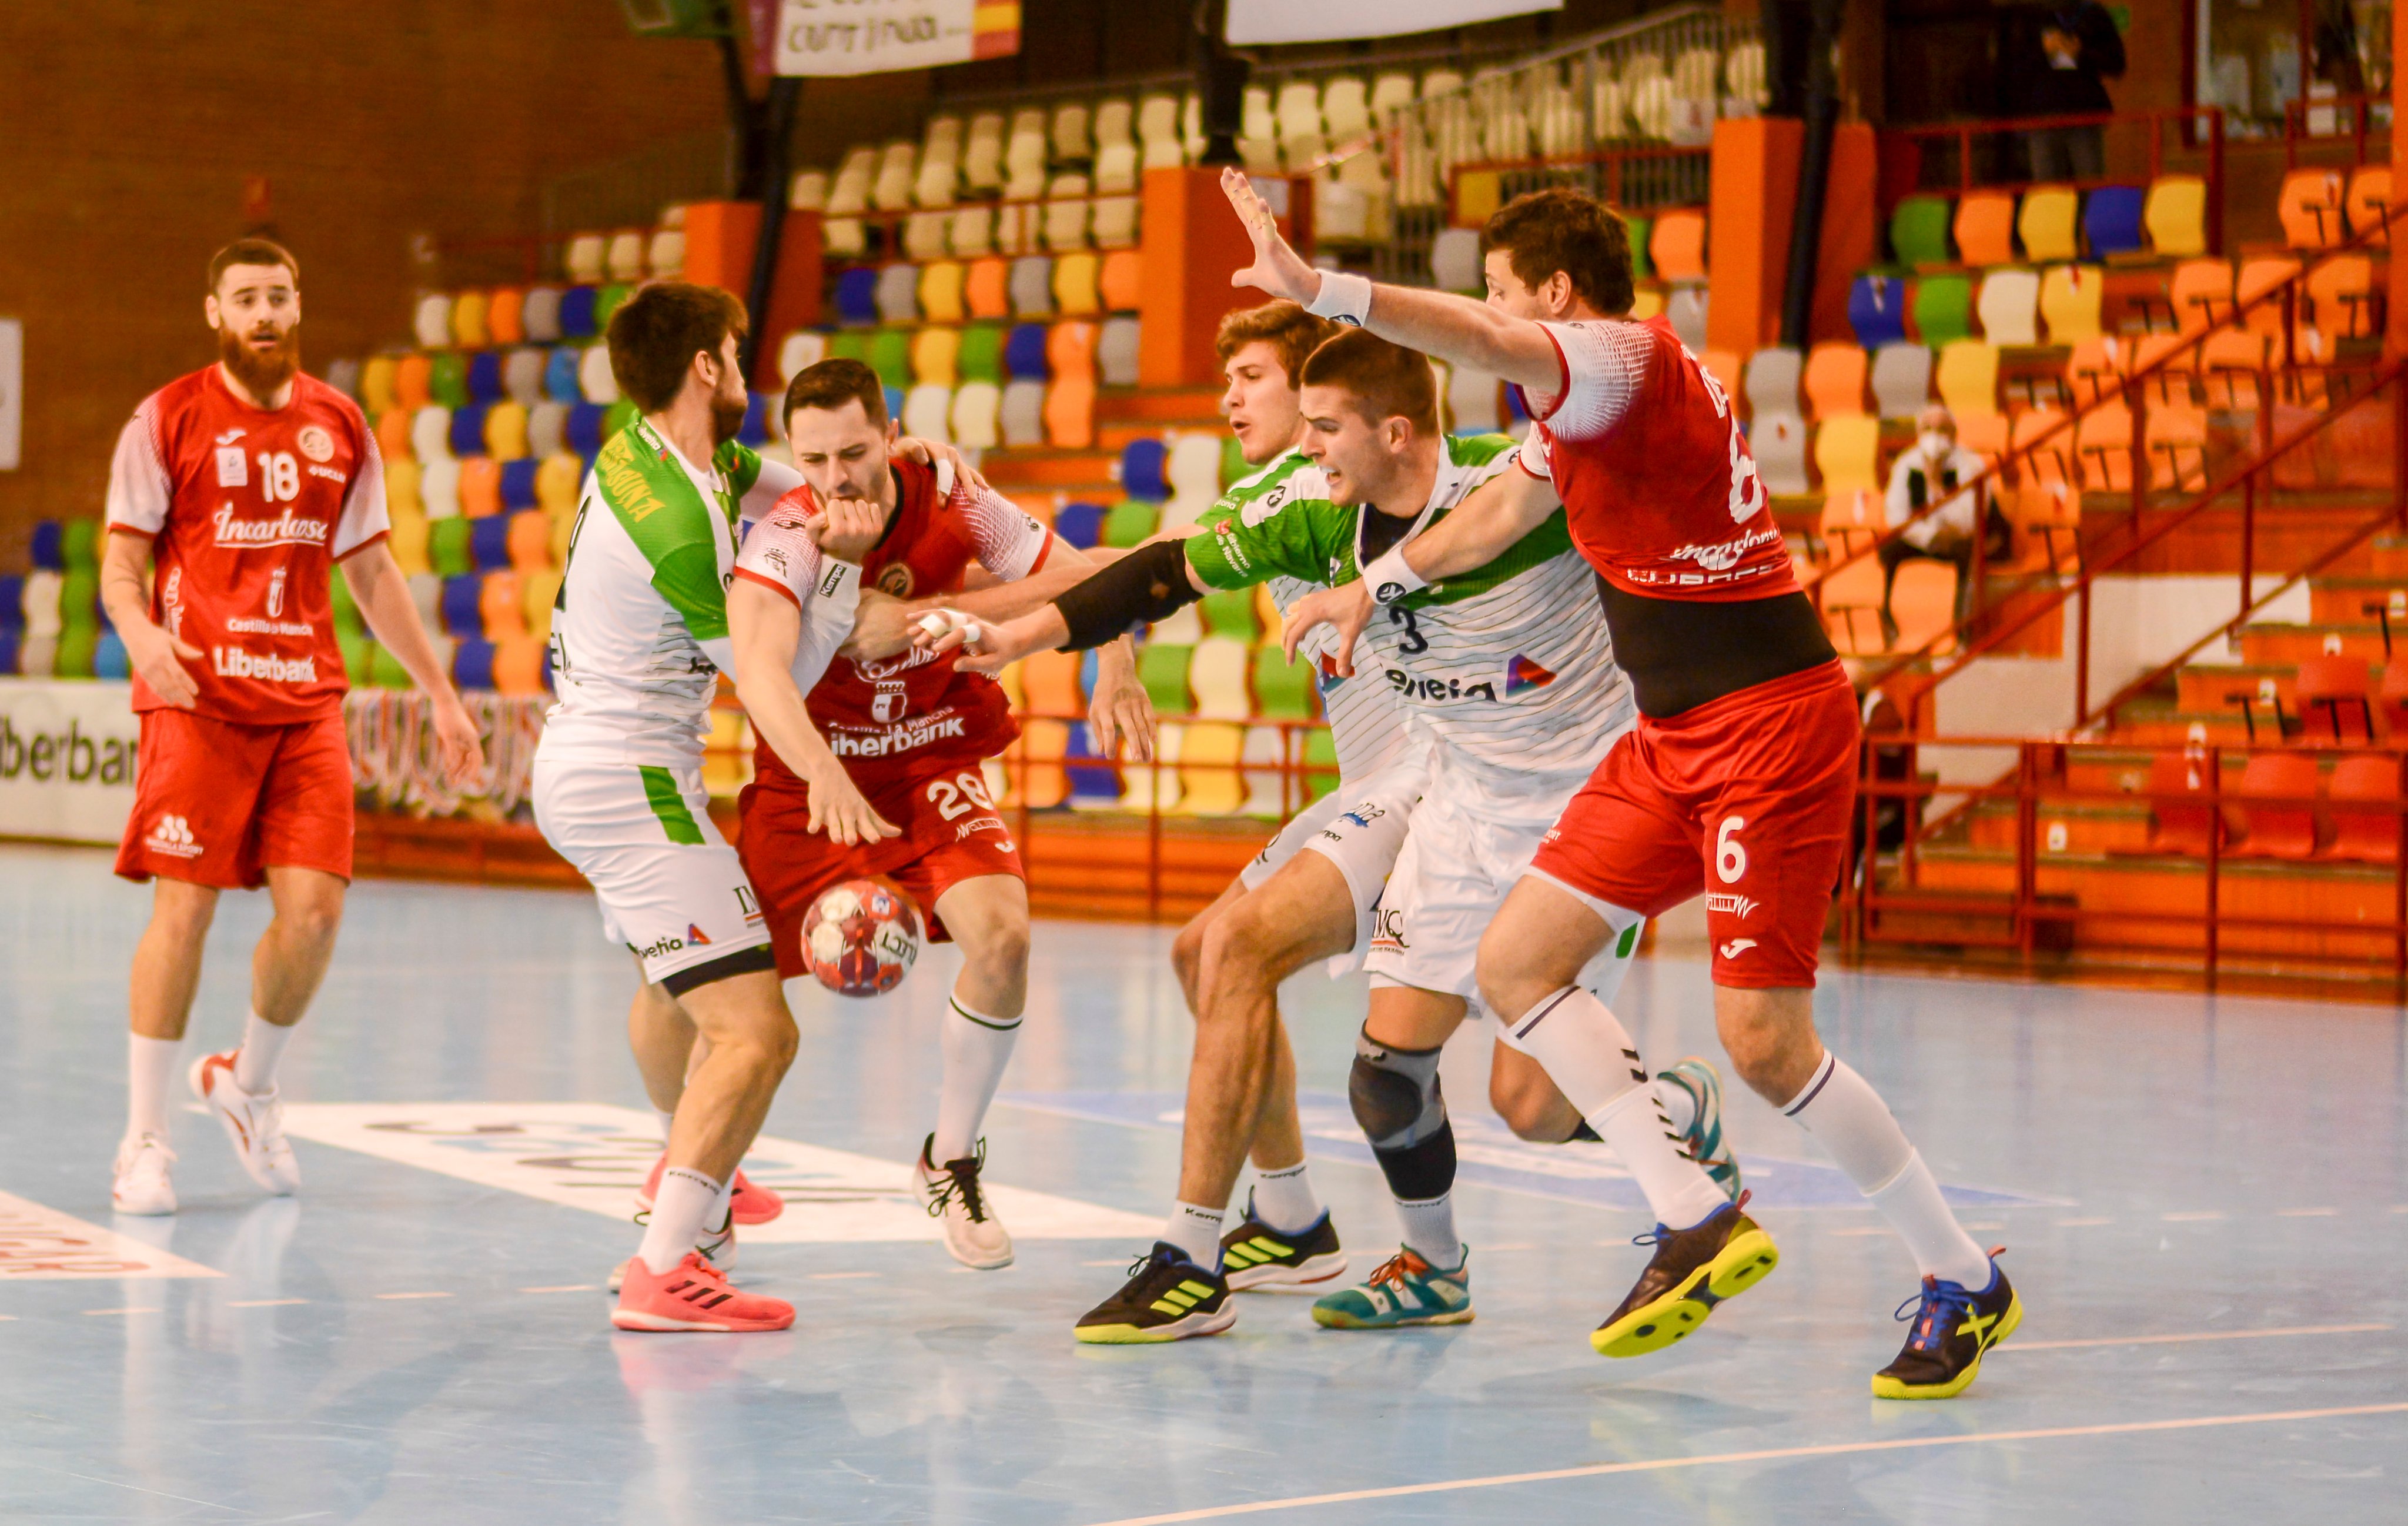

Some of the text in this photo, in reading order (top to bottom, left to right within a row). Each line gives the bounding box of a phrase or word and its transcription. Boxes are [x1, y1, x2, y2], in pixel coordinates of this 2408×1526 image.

[257, 452, 300, 502] 18
[820, 565, 844, 596] Kempa
[1389, 605, 1429, 655] 3
[1716, 816, 1745, 883] 6
